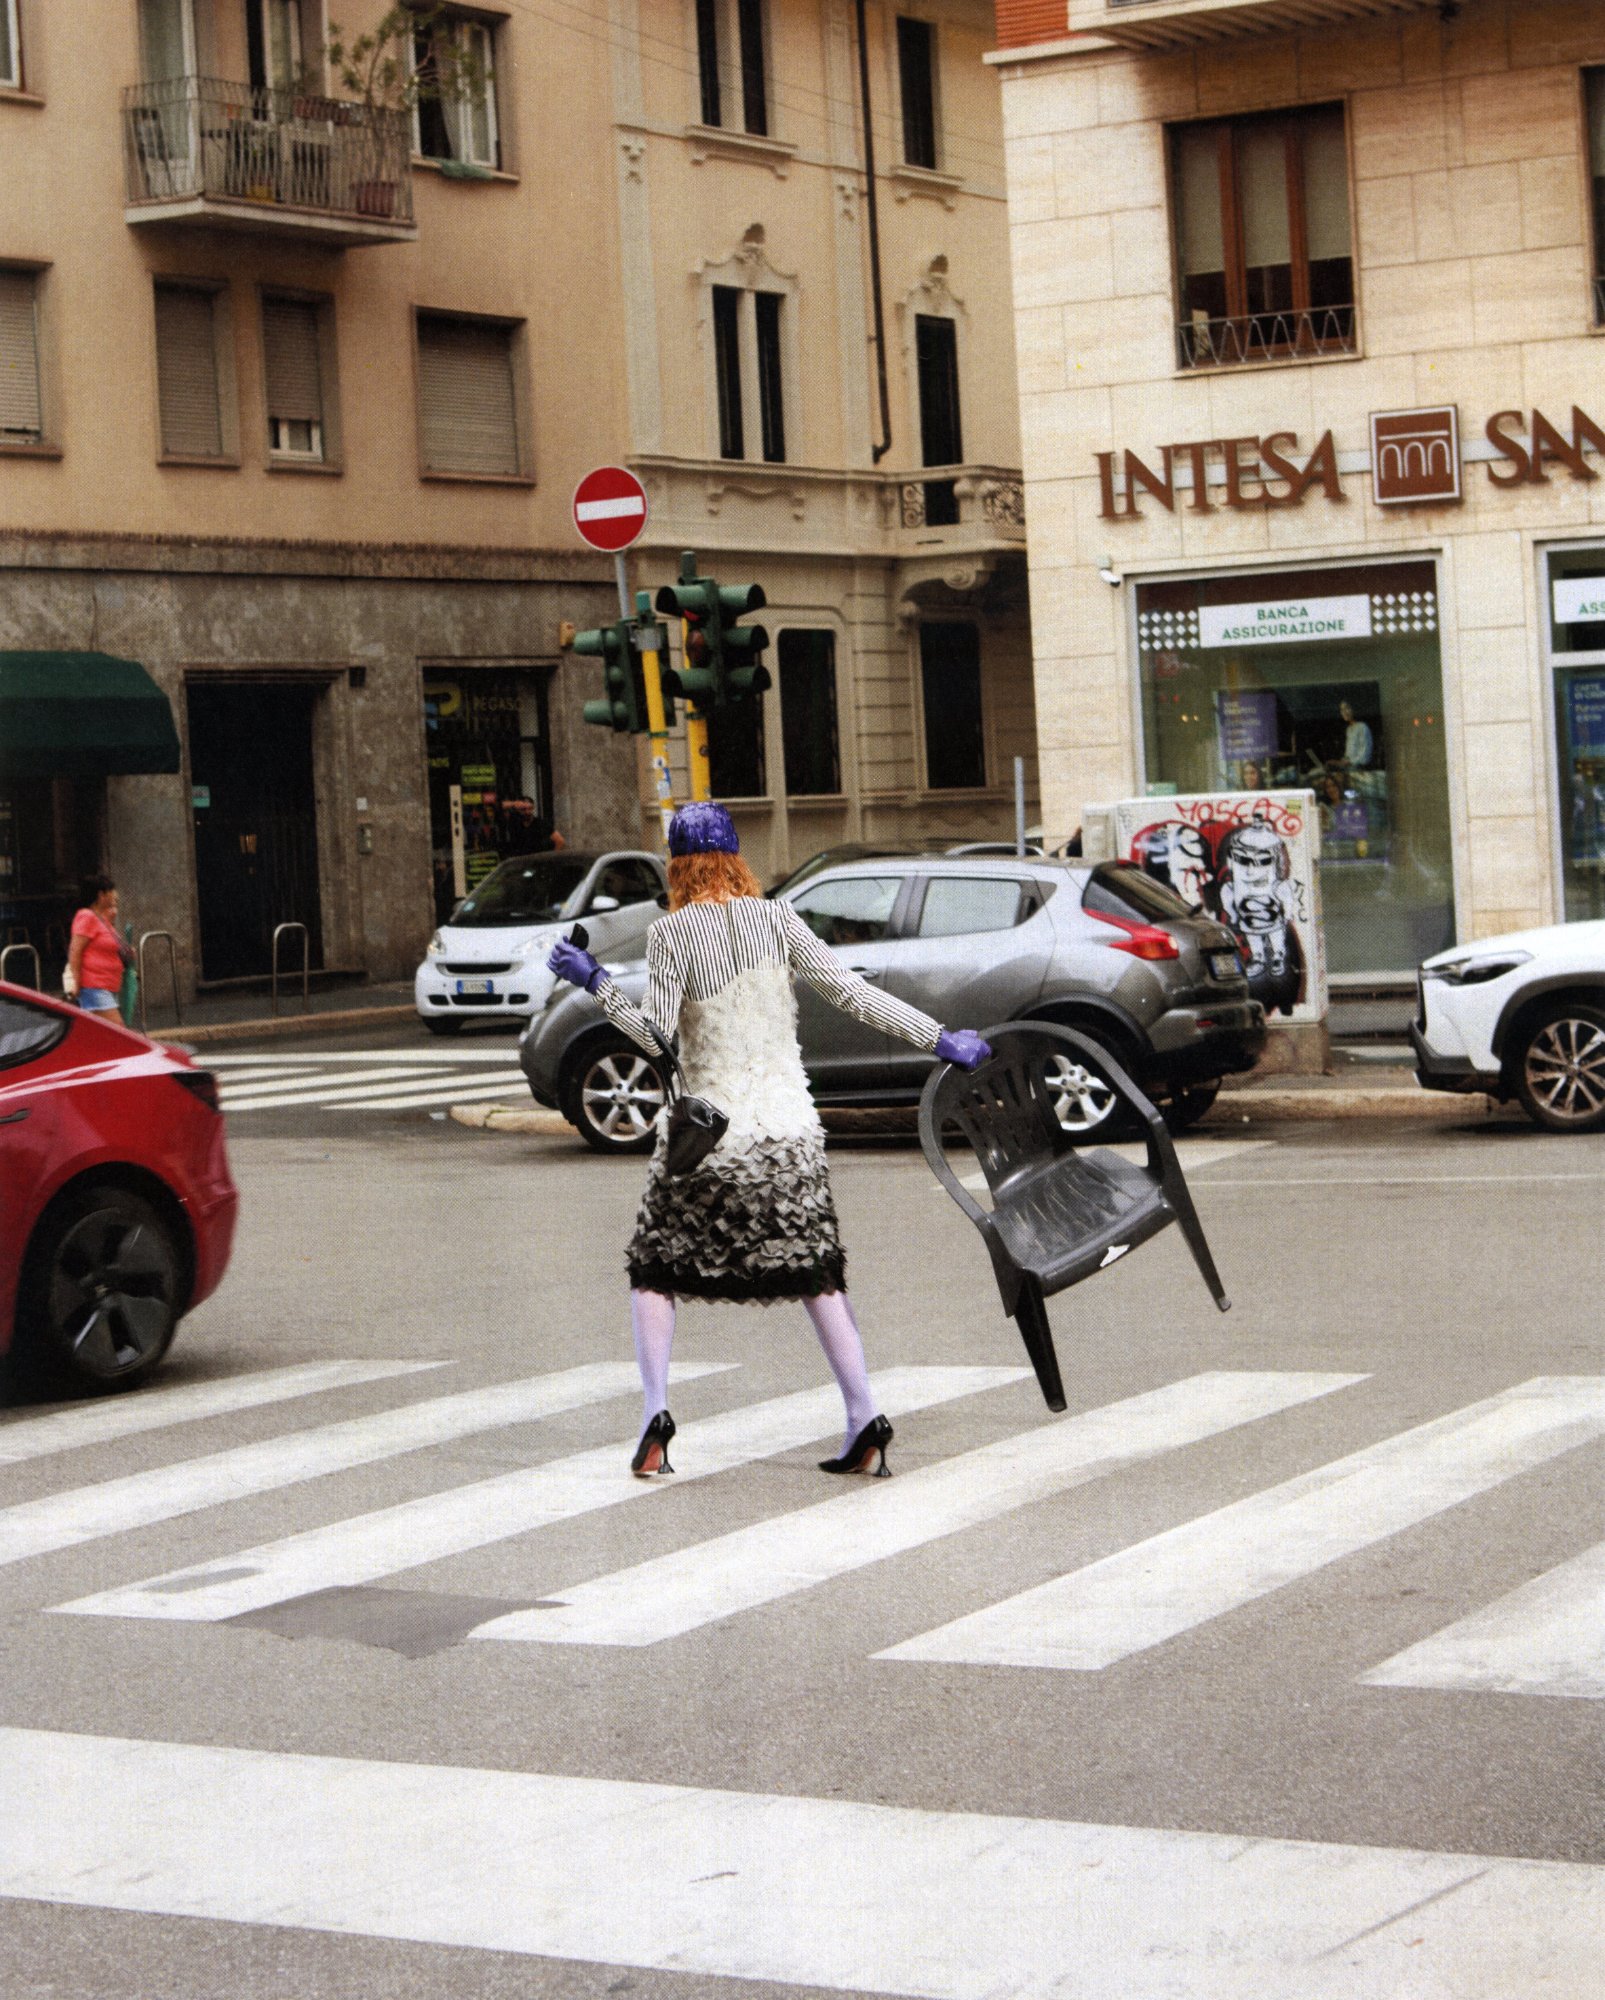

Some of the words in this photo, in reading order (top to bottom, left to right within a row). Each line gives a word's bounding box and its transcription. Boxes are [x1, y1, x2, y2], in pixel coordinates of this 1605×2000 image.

[1093, 429, 1347, 519] INTESA
[1257, 606, 1309, 621] BANCA
[1222, 619, 1345, 640] ASSICURAZIONE
